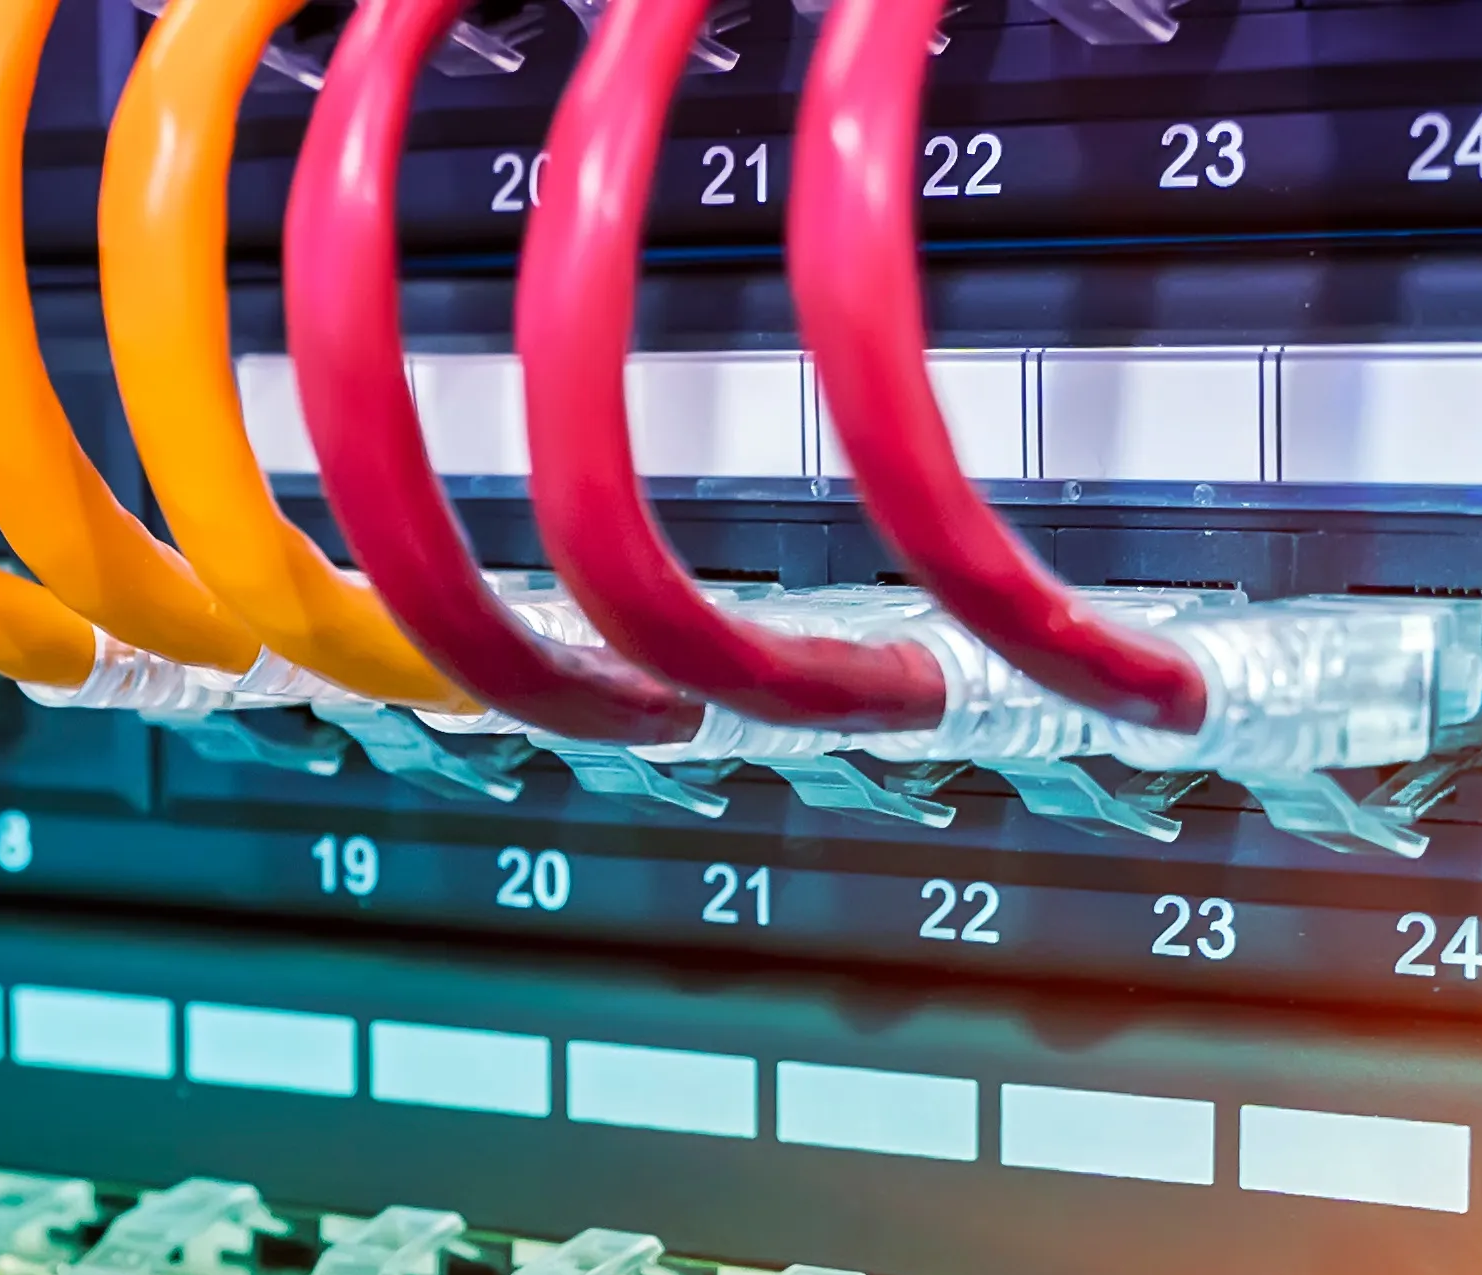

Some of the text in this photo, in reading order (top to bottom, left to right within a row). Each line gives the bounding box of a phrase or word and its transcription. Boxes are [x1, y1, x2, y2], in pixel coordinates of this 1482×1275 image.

[700, 143, 769, 206] 21
[922, 133, 1003, 197] 22
[1159, 121, 1246, 188] 23
[311, 836, 379, 896] 19
[496, 847, 571, 911] 20
[702, 864, 770, 926] 21
[919, 879, 1000, 944] 22
[1151, 894, 1237, 961] 23
